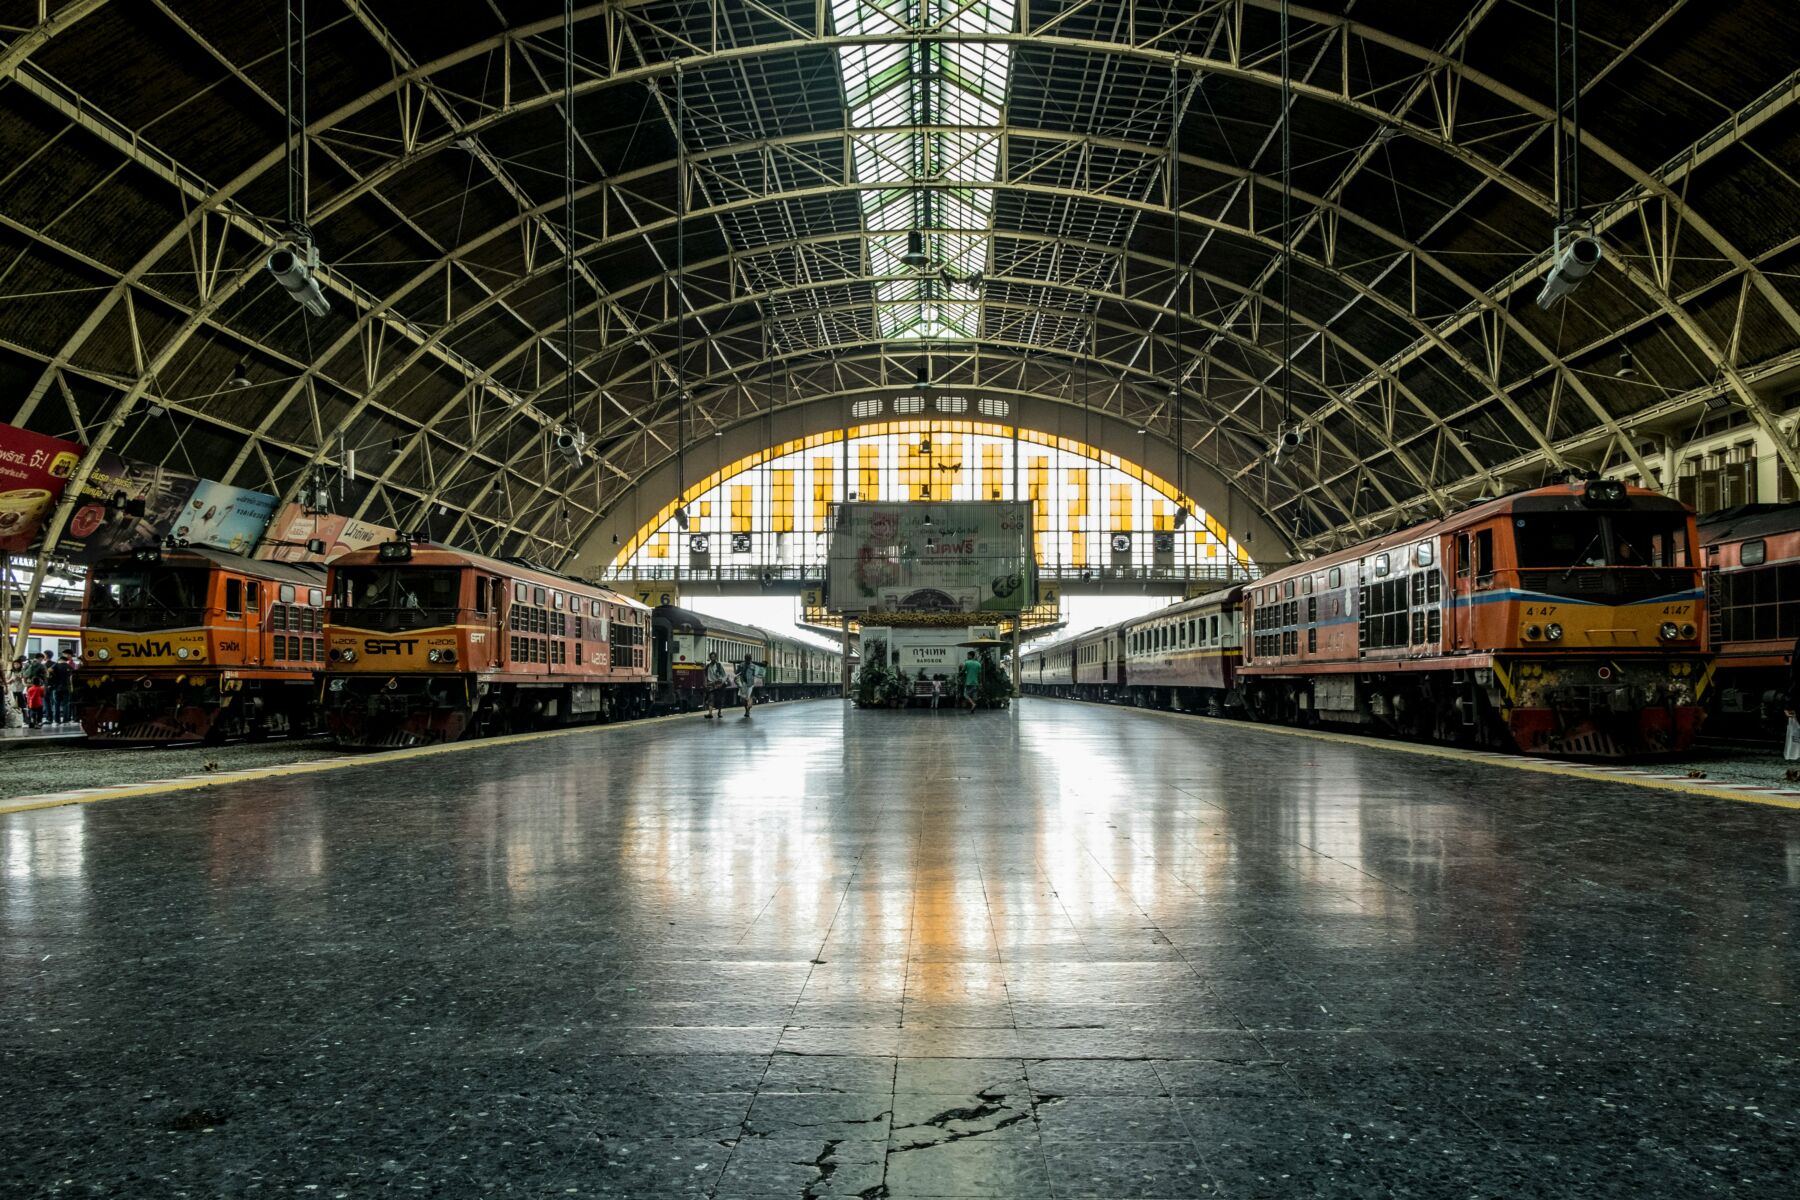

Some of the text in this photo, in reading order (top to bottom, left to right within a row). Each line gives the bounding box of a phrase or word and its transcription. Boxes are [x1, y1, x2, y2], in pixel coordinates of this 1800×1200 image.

[639, 592, 650, 604] 7
[660, 593, 671, 606] 6
[807, 592, 816, 604] 5
[1044, 591, 1056, 602] 4
[470, 632, 486, 643] SRT
[364, 639, 419, 655] SRT
[912, 648, 946, 657] กรุงเทพ
[591, 652, 608, 666] 4205
